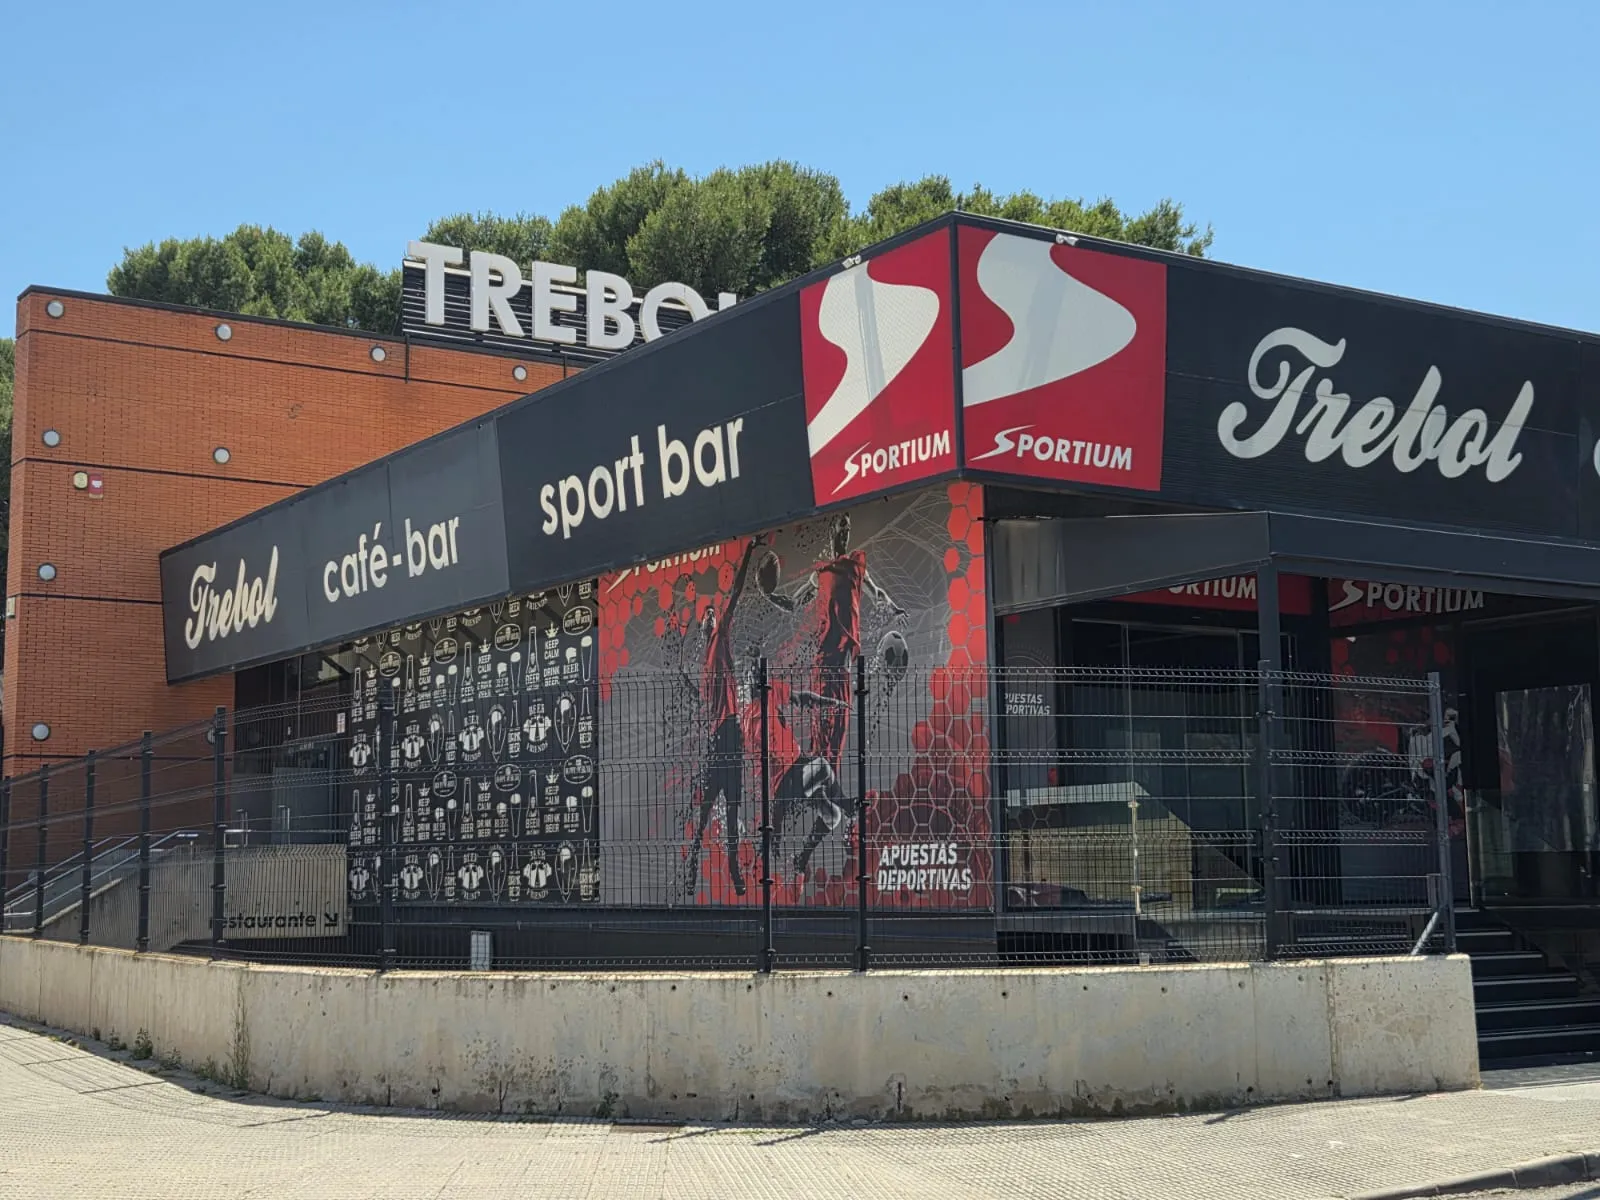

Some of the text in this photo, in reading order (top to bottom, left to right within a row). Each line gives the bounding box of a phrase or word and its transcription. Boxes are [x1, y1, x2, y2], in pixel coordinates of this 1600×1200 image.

[407, 240, 737, 350] TREBO
[1217, 327, 1534, 482] Trebol
[970, 424, 1132, 471] SPORTIUM
[831, 430, 951, 495] SPORTIUM
[540, 417, 744, 540] sport bar
[323, 516, 460, 603] café-bar
[185, 544, 279, 650] Trebol
[1168, 576, 1257, 600] RTIUM
[1328, 580, 1485, 614] SPORTIUM
[544, 649, 559, 660] CALM
[545, 639, 559, 649] KEEP
[544, 666, 560, 678] DRINK
[544, 676, 559, 687] BEER
[1004, 692, 1044, 704] PUESTAS
[1005, 703, 1051, 716] PORTIVAS
[879, 843, 958, 867] APUESTAS
[877, 868, 972, 891] DEPORTIVAS
[210, 911, 317, 929] staurante
